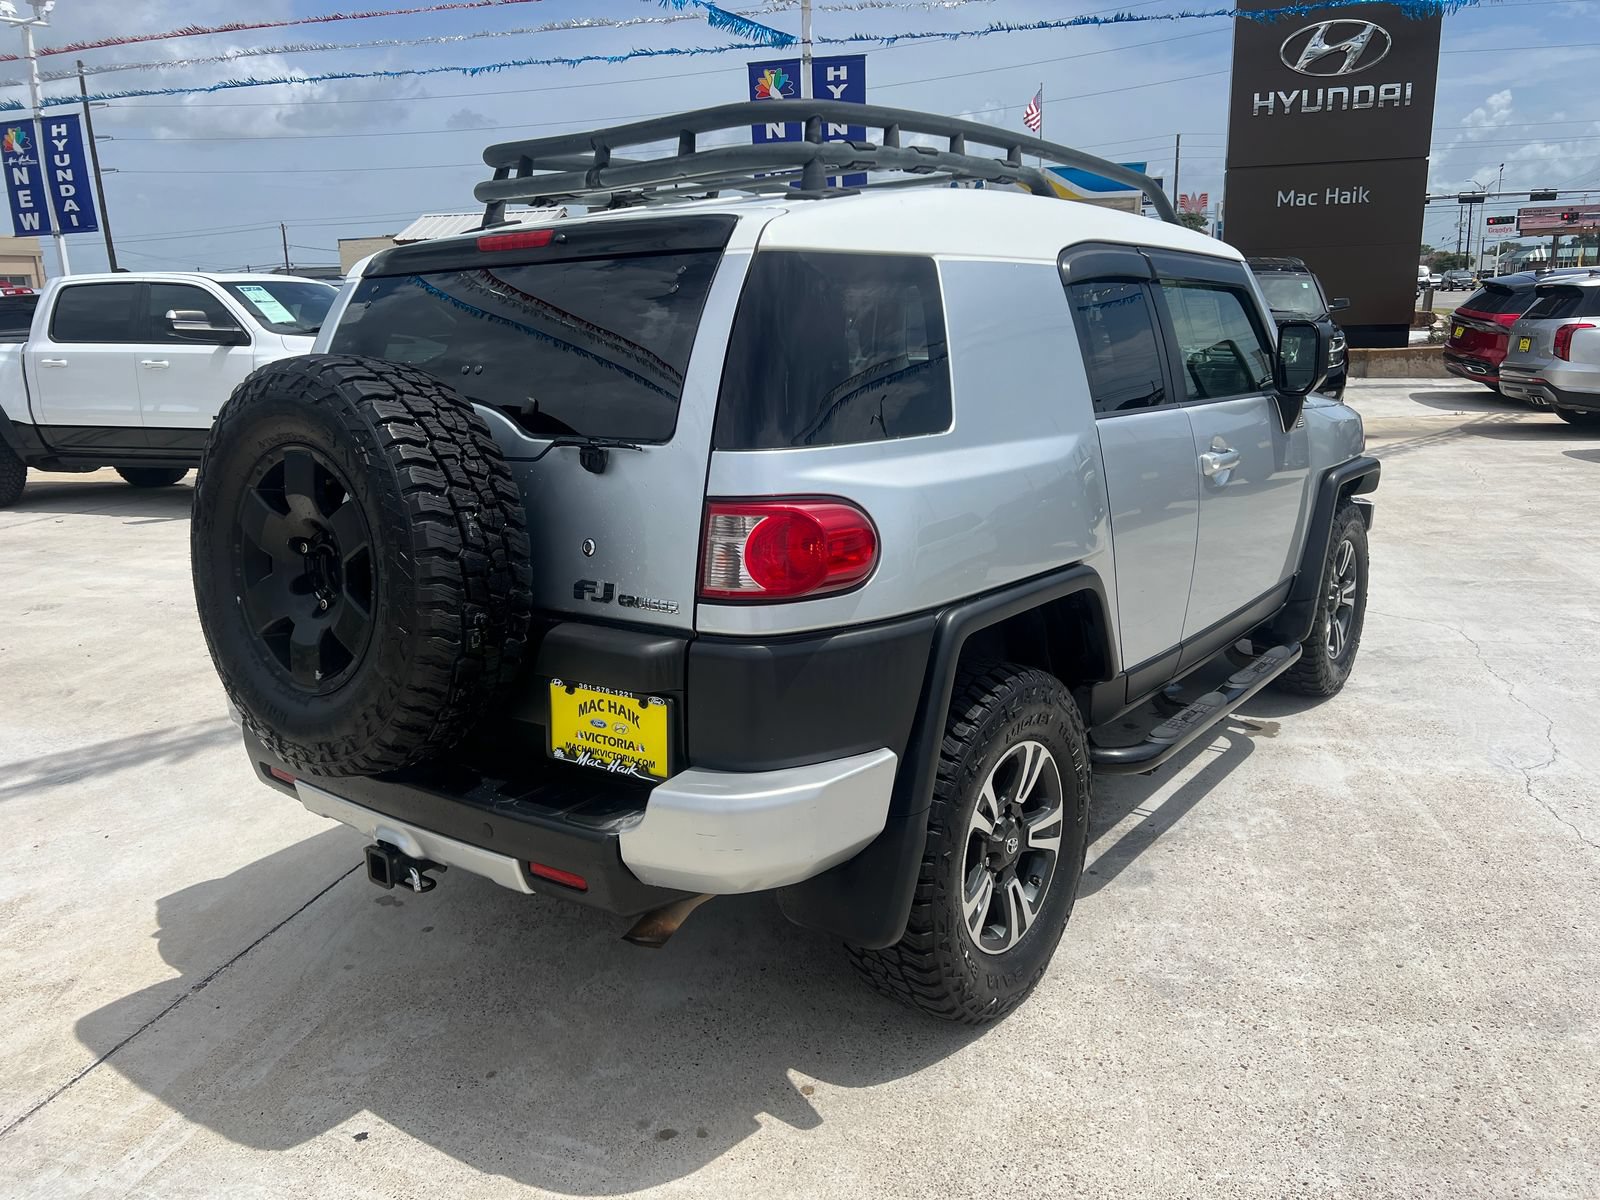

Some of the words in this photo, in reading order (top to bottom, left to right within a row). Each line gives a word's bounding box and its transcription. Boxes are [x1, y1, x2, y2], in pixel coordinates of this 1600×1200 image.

[1252, 82, 1413, 116] HYUNDAI
[51, 123, 80, 227] HYUNDAI
[12, 166, 40, 231] NEW
[1276, 189, 1318, 208] Mac
[1325, 186, 1370, 205] Haik
[573, 579, 615, 604] FJ
[578, 698, 605, 718] MAC
[608, 699, 641, 730] HAIK
[583, 731, 636, 752] VICTORIA
[576, 750, 605, 768] Mac
